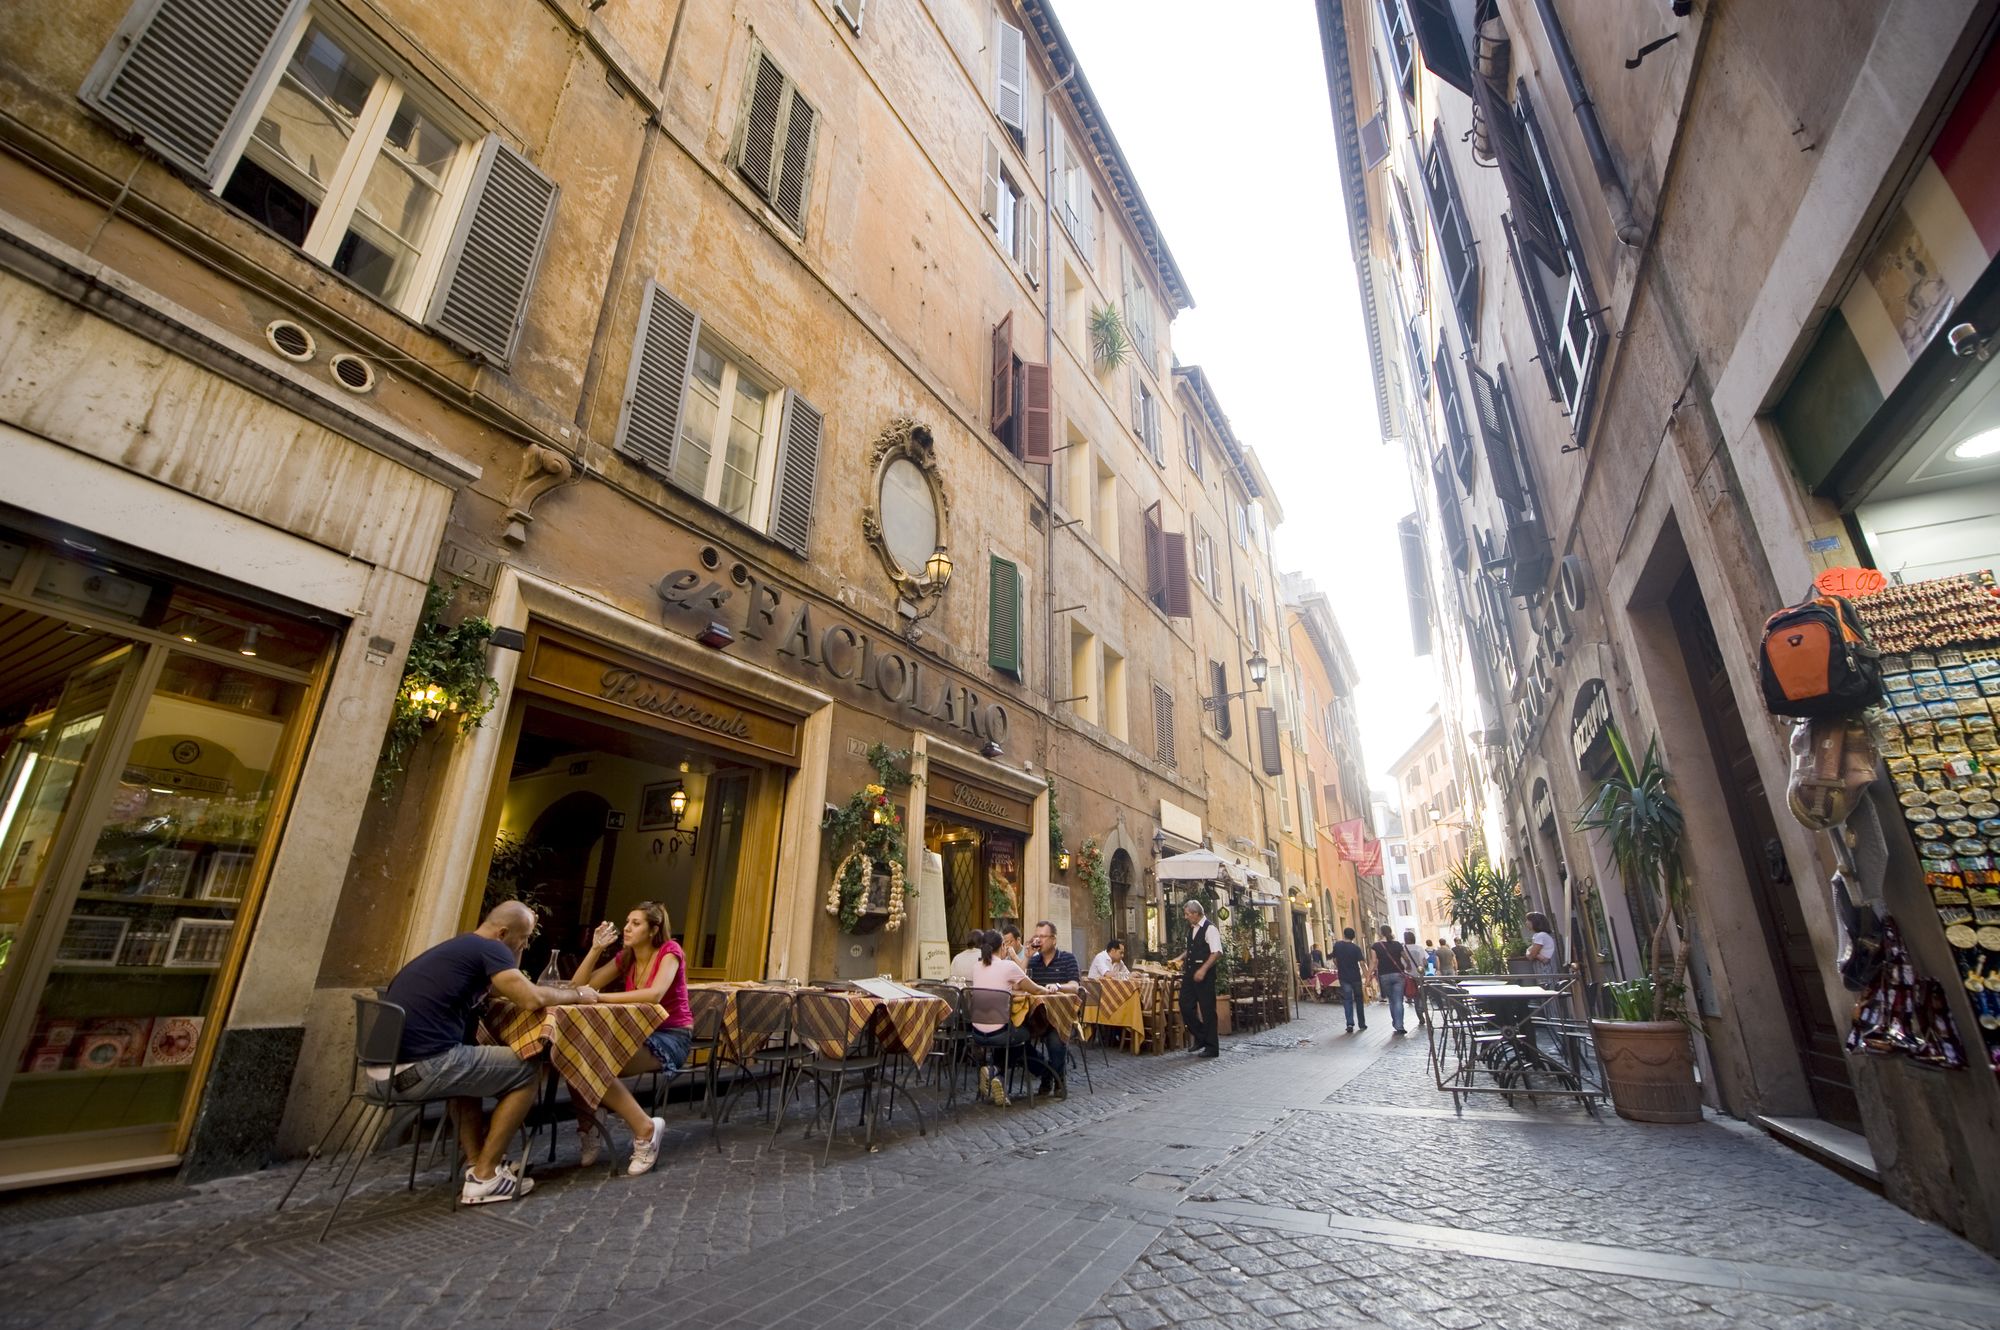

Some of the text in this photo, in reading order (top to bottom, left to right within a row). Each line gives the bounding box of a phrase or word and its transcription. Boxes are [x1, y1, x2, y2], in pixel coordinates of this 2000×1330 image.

[449, 547, 490, 581] 121
[740, 574, 1008, 745] FACIOLARO
[601, 667, 753, 740] Ristorante
[1573, 684, 1609, 771] pizzeria
[848, 738, 865, 757] 122
[952, 782, 1008, 817] Pizzeria
